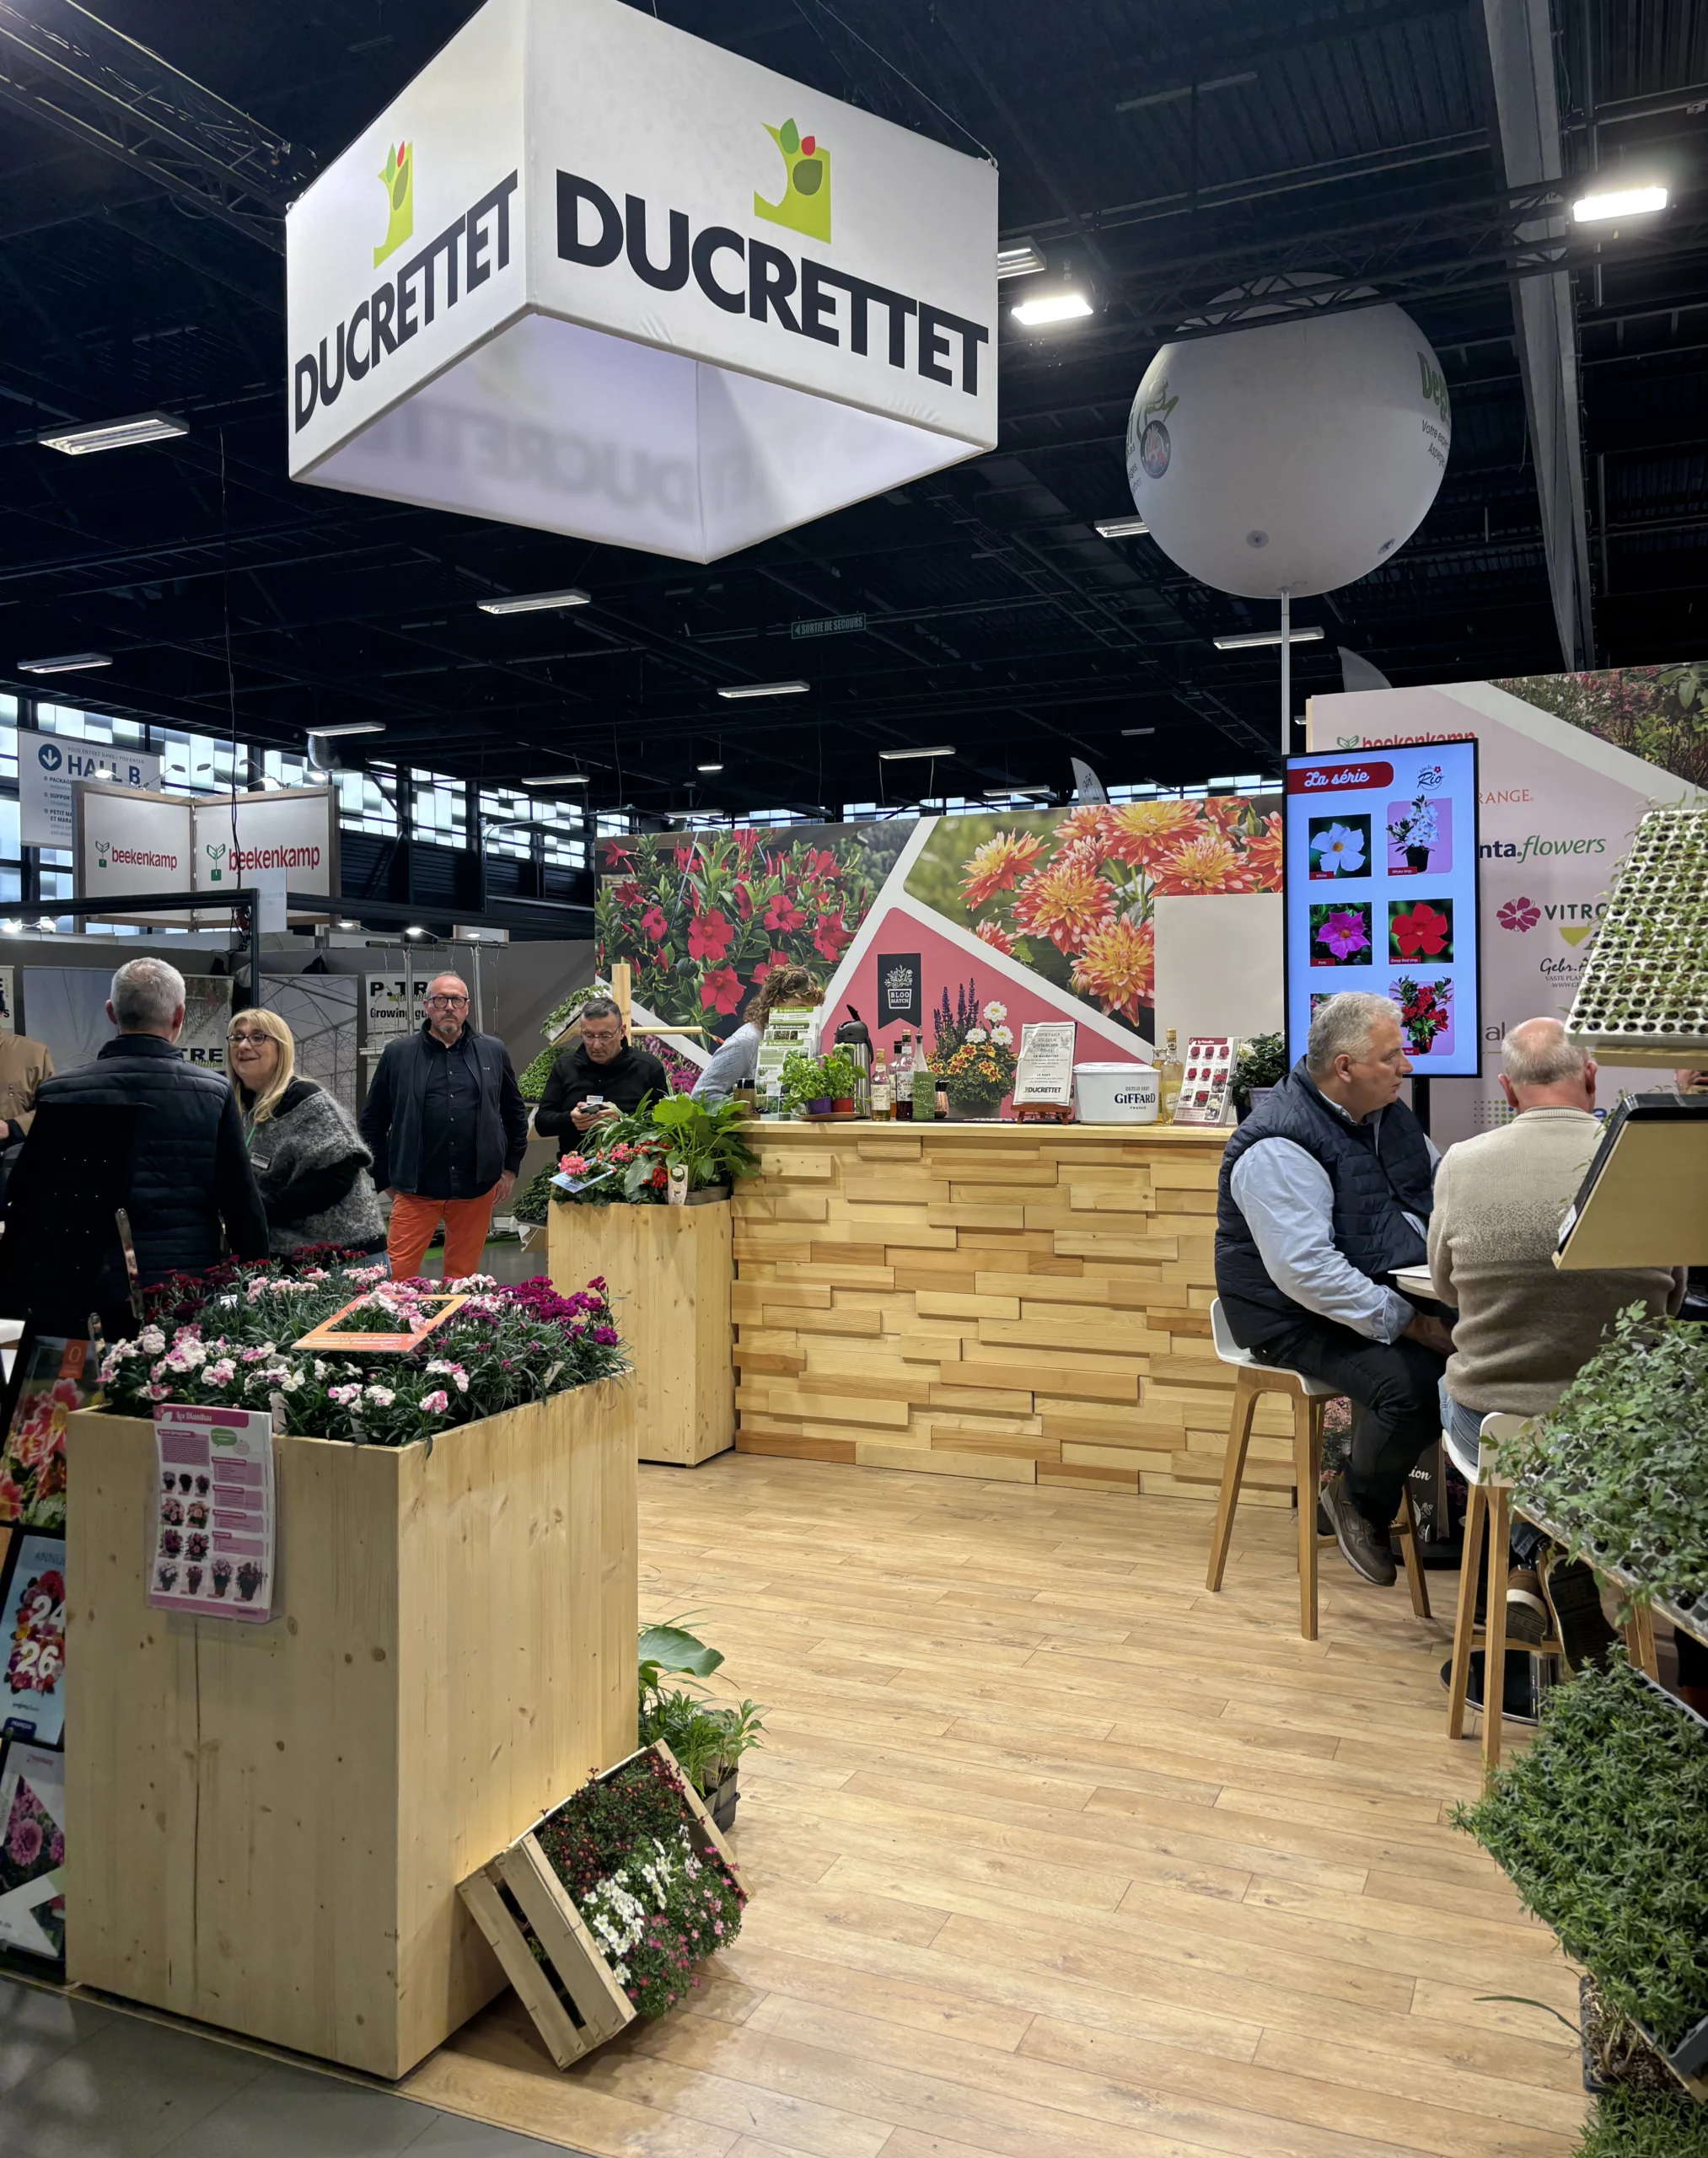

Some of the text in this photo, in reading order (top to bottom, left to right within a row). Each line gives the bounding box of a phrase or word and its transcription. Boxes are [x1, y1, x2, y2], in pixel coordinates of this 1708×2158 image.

[556, 169, 989, 397] DUCRETTET
[295, 168, 518, 434] DUCRETTET
[802, 616, 862, 635] SORTIE DE SECOURS
[129, 765, 141, 785] B
[1304, 768, 1370, 787] La série
[1417, 771, 1445, 788] Rio
[111, 846, 178, 872] beekenkamp
[228, 845, 320, 872] beekenkamp
[1517, 835, 1606, 864] flowers
[16, 1640, 59, 1680] 26
